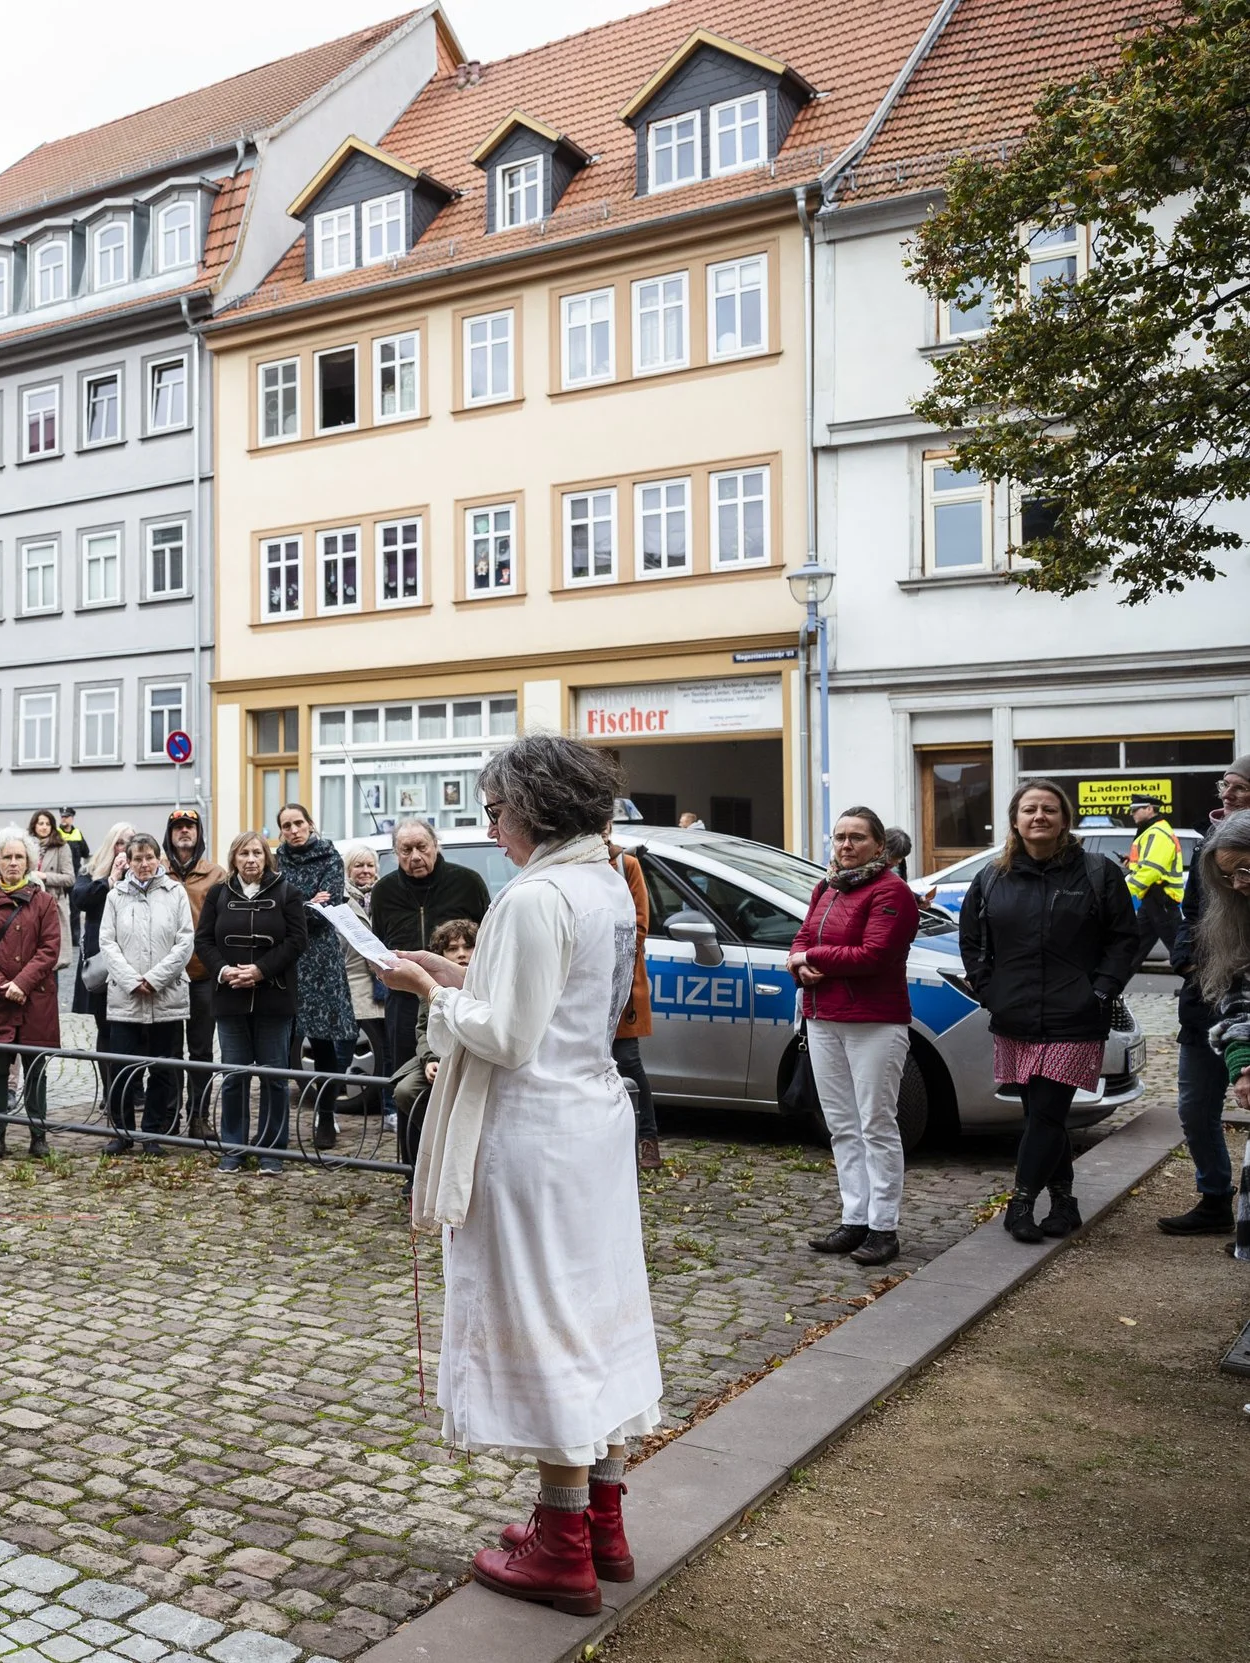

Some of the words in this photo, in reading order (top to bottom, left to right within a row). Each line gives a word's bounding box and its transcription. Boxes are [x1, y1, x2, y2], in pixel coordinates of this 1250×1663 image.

[587, 707, 669, 734] Fischer
[1089, 783, 1160, 793] Ladenlokal
[1101, 794, 1167, 803] vermen
[1079, 806, 1113, 815] 03621
[647, 974, 743, 1008] LIZEI
